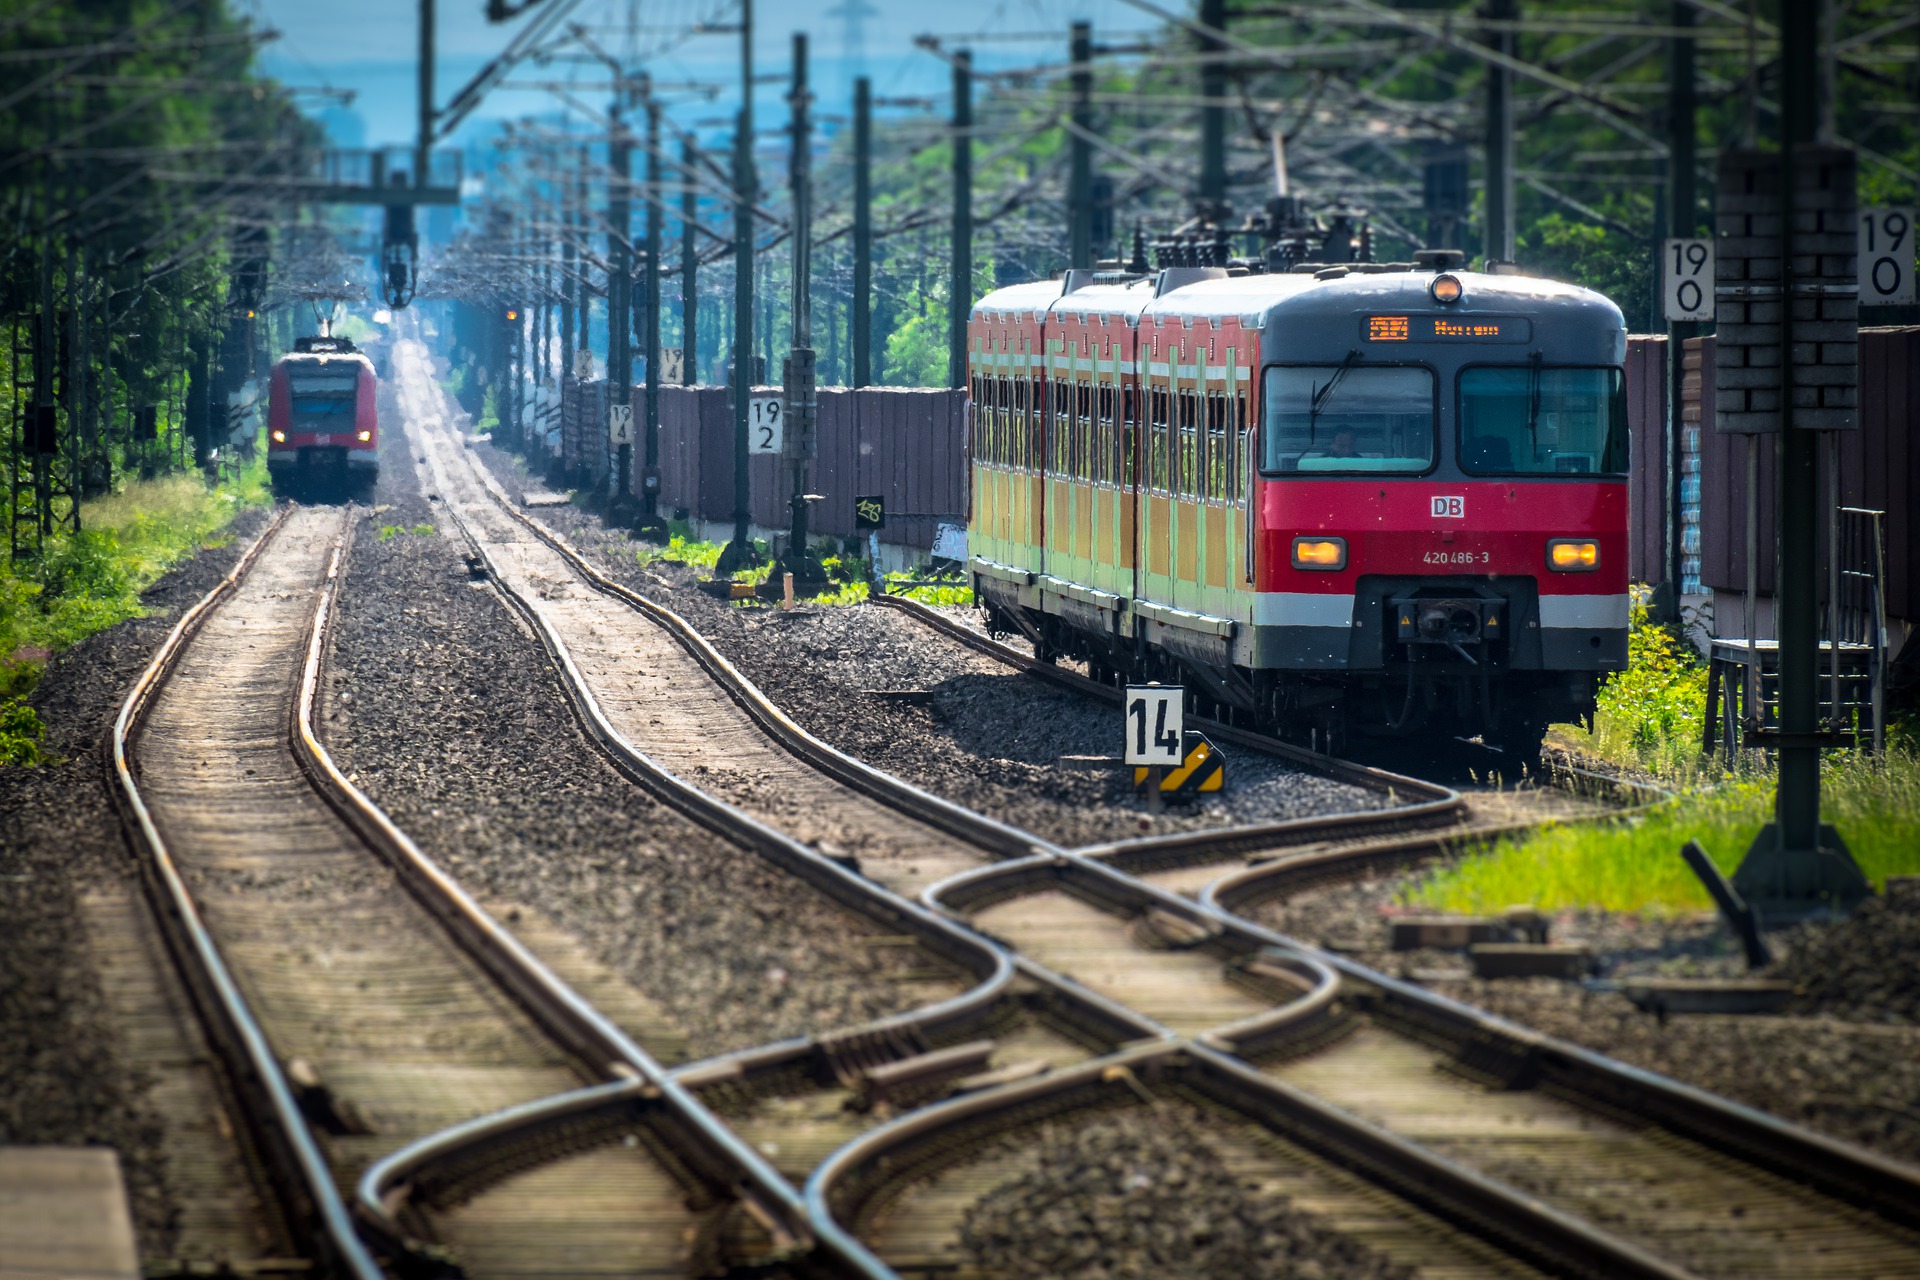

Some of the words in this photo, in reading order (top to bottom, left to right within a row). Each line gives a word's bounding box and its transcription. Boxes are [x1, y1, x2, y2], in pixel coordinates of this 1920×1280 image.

[1863, 213, 1908, 252] 19
[1672, 244, 1708, 275] 19
[1871, 257, 1901, 295] 0
[1677, 280, 1702, 312] 0
[665, 349, 683, 363] 19
[668, 365, 678, 380] 4
[613, 406, 631, 422] 19
[754, 401, 780, 424] 19
[617, 423, 627, 439] 4
[758, 427, 774, 449] 2
[1433, 497, 1462, 515] DB
[1129, 698, 1179, 756] 14
